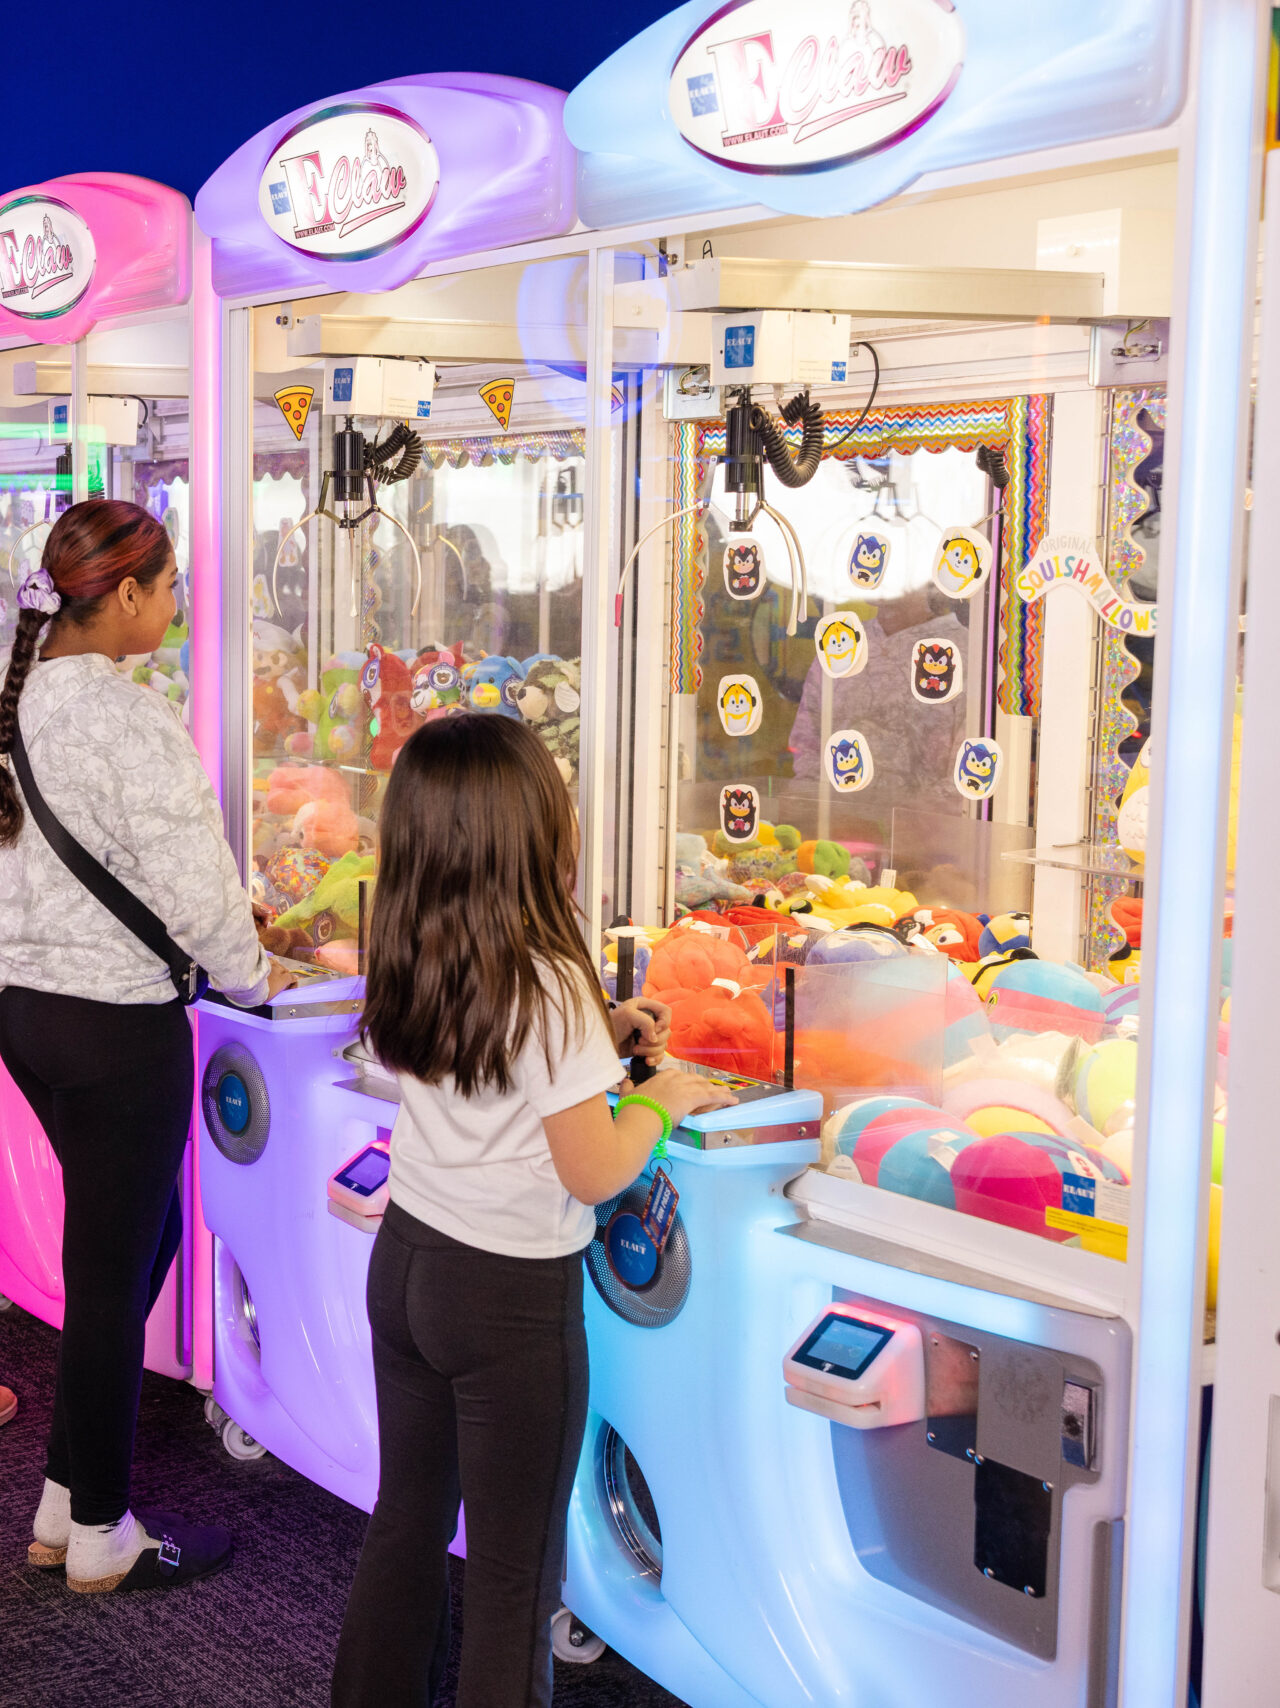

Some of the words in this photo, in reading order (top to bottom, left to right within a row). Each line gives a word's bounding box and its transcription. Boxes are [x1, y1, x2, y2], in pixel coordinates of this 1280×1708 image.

[722, 125, 788, 147] WWW.ELAUT.COM
[702, 239, 714, 259] A
[1063, 1184, 1096, 1200] ELAUT
[620, 1239, 646, 1255] ELAUT
